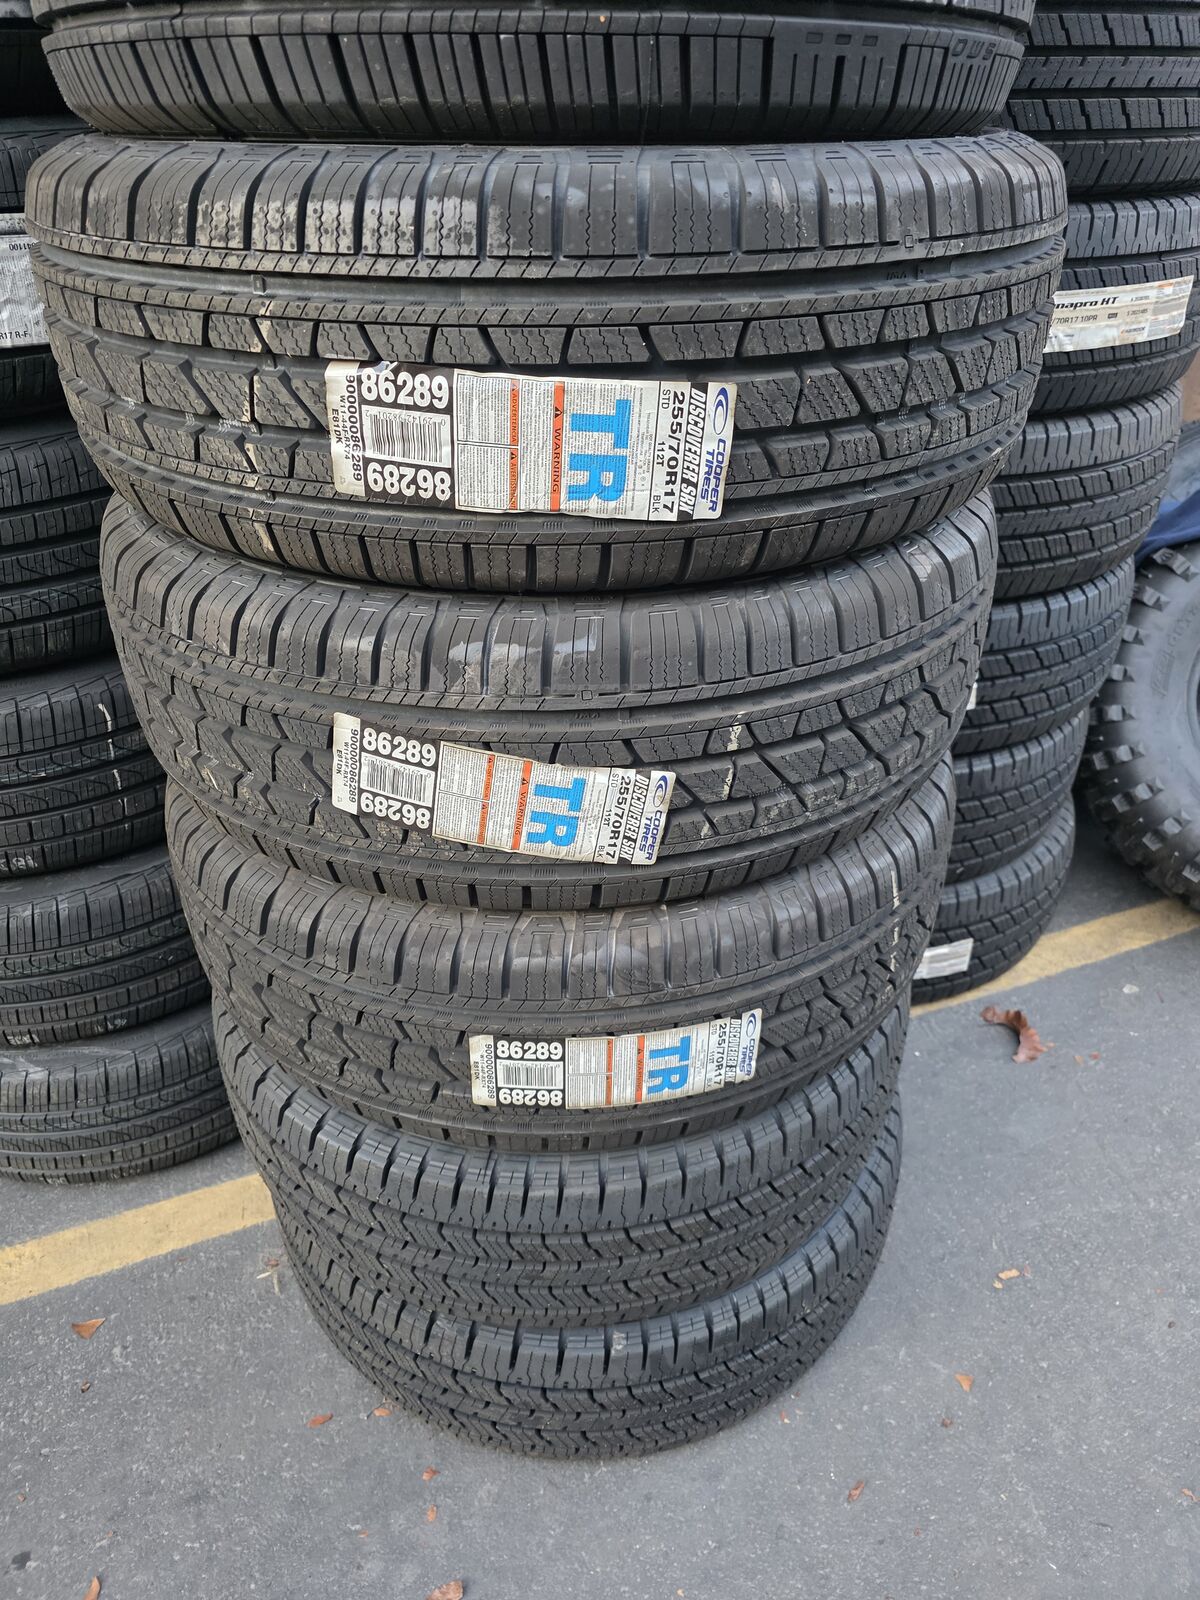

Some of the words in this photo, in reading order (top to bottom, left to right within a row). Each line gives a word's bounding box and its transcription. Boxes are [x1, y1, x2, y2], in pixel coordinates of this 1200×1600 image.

[1079, 314, 1098, 323] 10PR
[1100, 295, 1119, 306] HT
[360, 367, 450, 409] 86289
[661, 389, 671, 410] STD
[331, 408, 344, 445] E81DK
[345, 374, 363, 482] 90000086289
[681, 387, 706, 480] DISCOVERER
[552, 428, 562, 493] WARNING
[567, 399, 632, 501] TR
[656, 440, 666, 468] 112T
[662, 390, 686, 514] 255/70R17
[367, 461, 452, 501] 86289
[700, 448, 715, 500] TIRES
[708, 438, 727, 513] COOPER
[651, 495, 661, 514] BLK
[678, 481, 697, 516] SRX
[348, 728, 359, 803] 90000086289
[362, 727, 437, 767] 86289
[360, 792, 431, 829] 86289
[515, 791, 527, 836] WARNING
[526, 777, 587, 847] TR
[603, 809, 612, 827] 112T
[606, 775, 631, 860] 255/70R17
[624, 774, 650, 840] DISCOVERER
[596, 845, 606, 858] BLK
[619, 838, 635, 862] SRX
[639, 816, 653, 852] TIRES
[645, 810, 663, 861] COOPER
[496, 1040, 563, 1060] 86289
[713, 1022, 727, 1086] 255/70R17
[726, 1019, 742, 1067] DISCOVERER
[739, 1046, 749, 1073] TIRES
[745, 1038, 756, 1076] COOPER
[485, 1043, 496, 1099] 90000086289
[647, 1035, 692, 1095] TR
[498, 1088, 563, 1107] 86289
